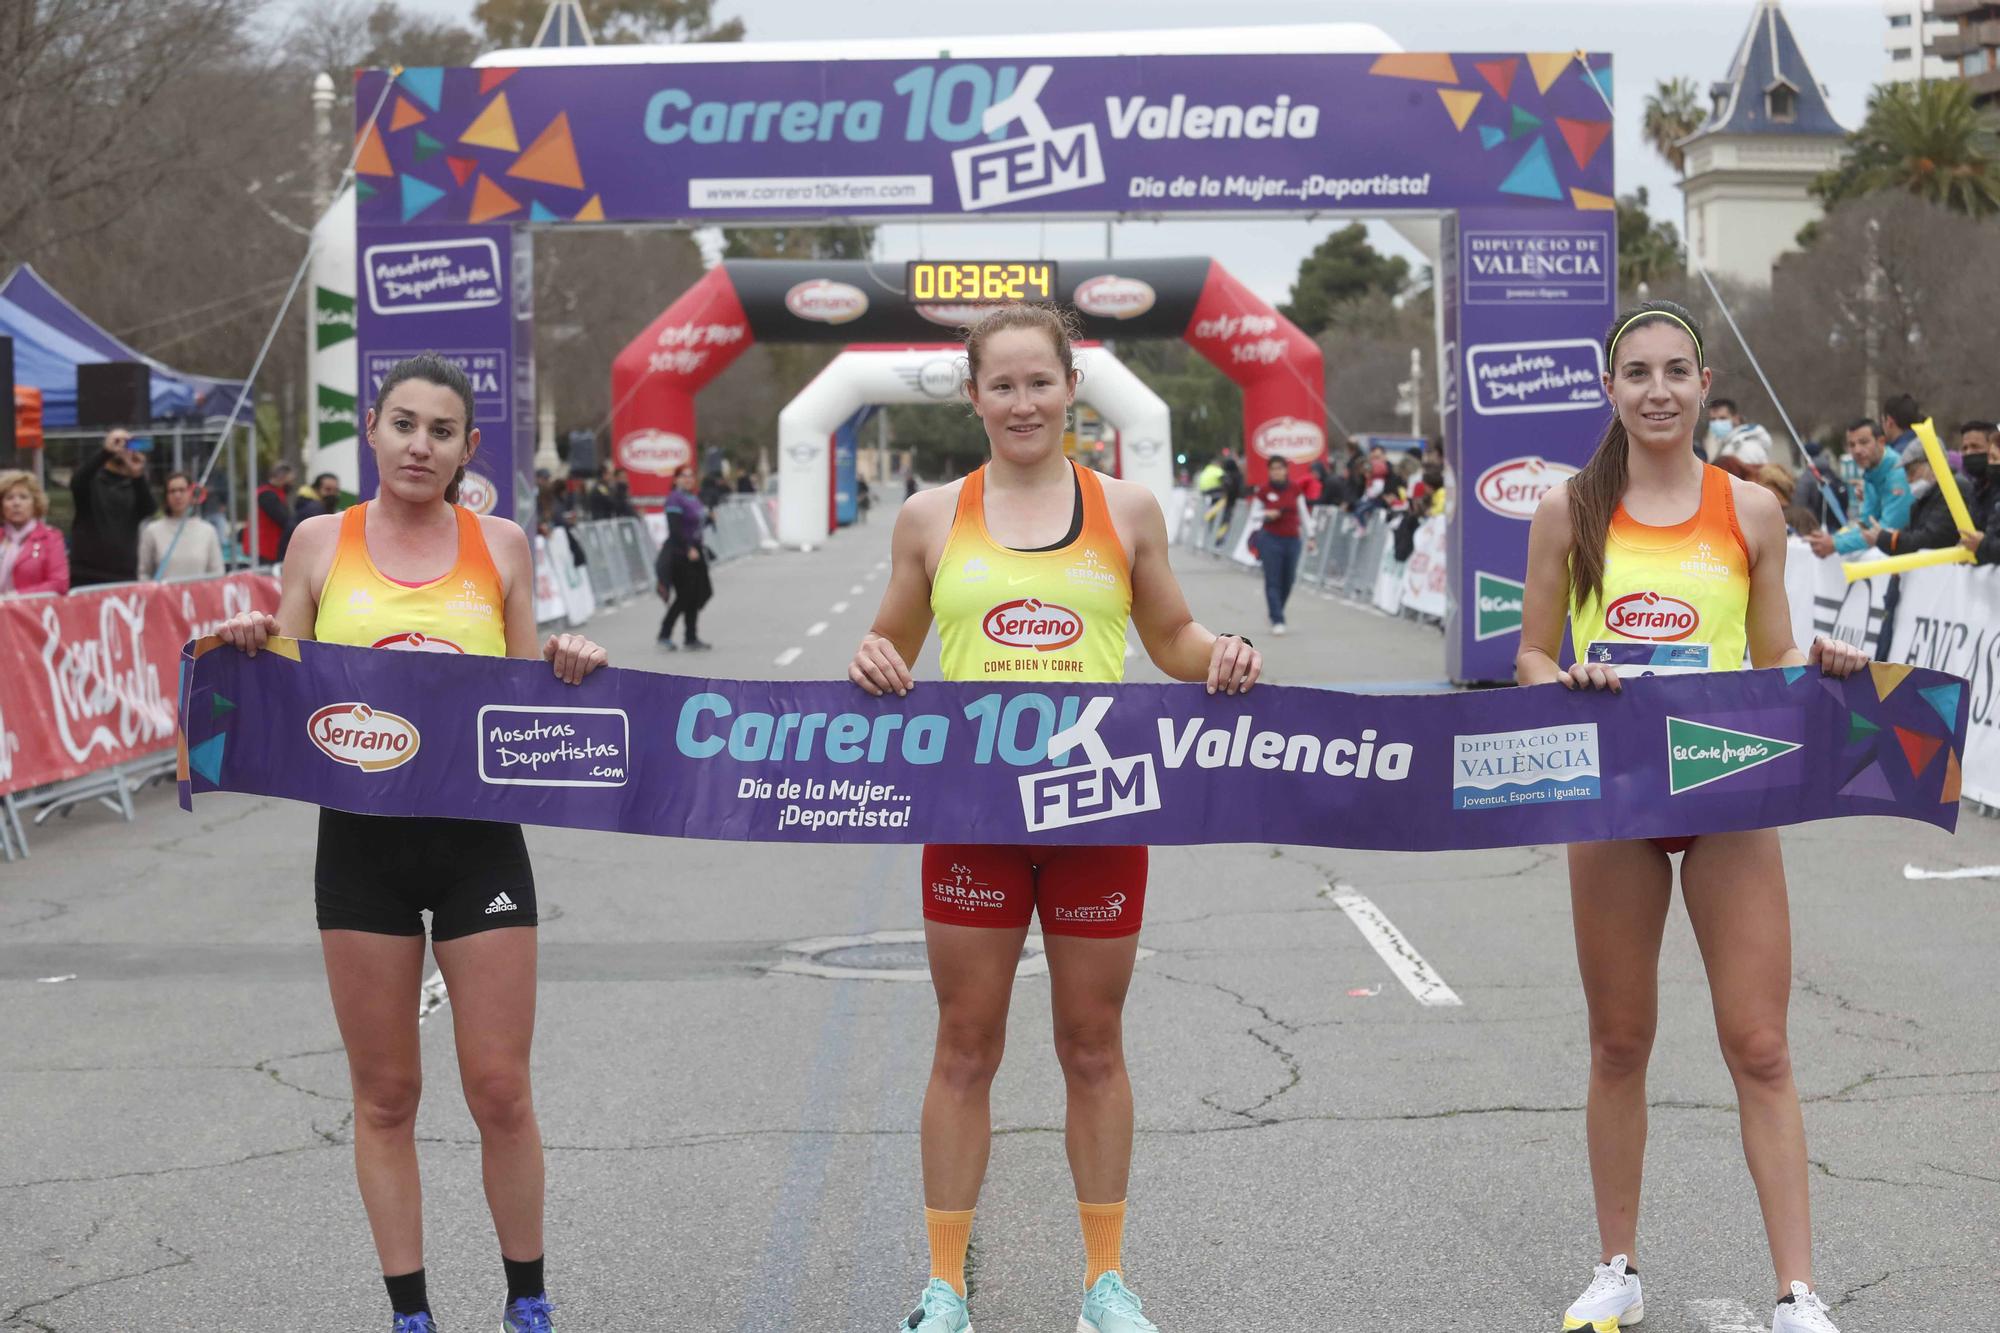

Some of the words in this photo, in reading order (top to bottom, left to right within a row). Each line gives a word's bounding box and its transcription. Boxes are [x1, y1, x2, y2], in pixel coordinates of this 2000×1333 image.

[644, 88, 883, 144] Carrera
[893, 64, 1054, 142] 10K
[1105, 94, 1319, 140] Valencia
[971, 133, 1087, 201] FEM
[706, 183, 916, 201] www.carrera10kfem.com
[1129, 176, 1165, 198] Día
[1170, 176, 1196, 197] de
[1200, 175, 1222, 197] la
[1576, 239, 1599, 251] DE
[383, 264, 490, 300] Deportistas
[914, 264, 1049, 299] 00:36:24
[1485, 365, 1594, 401] Deportistas
[1491, 477, 1550, 501] Serra
[993, 613, 1075, 636] Serrano
[1612, 606, 1692, 628] Serrano
[984, 660, 1012, 672] COME
[1015, 659, 1039, 671] BIEN
[1043, 660, 1049, 670] Y
[1051, 660, 1084, 672] CORRE
[319, 717, 408, 751] Serrano
[490, 719, 575, 743] nosotras
[676, 693, 949, 764] Carrera
[964, 693, 1114, 767] 10K
[1461, 732, 1557, 752] DIPUTACIÓ
[1566, 731, 1589, 742] DE
[497, 738, 619, 771] Deportistas
[1157, 715, 1413, 781] Valencia
[1673, 745, 1688, 760] El
[1688, 745, 1720, 760] Corte
[1722, 740, 1768, 764] Inglés
[589, 764, 624, 778] .com
[1461, 748, 1592, 777] VALÈNCIA
[738, 778, 771, 799] Día
[776, 778, 801, 799] de
[805, 778, 824, 800] la
[829, 780, 911, 805] Mujer...
[1034, 761, 1145, 825] FEM
[1462, 795, 1507, 808] Joventut,
[1510, 791, 1545, 803] Esports
[1554, 786, 1590, 799] Igualtat
[778, 805, 911, 831] ¡Deportista!
[932, 883, 1005, 901] SERRANO
[934, 894, 952, 903] CLUB
[954, 898, 1003, 908] ATLETISMO
[485, 904, 517, 914] adidas
[1055, 907, 1117, 918] Paterna
